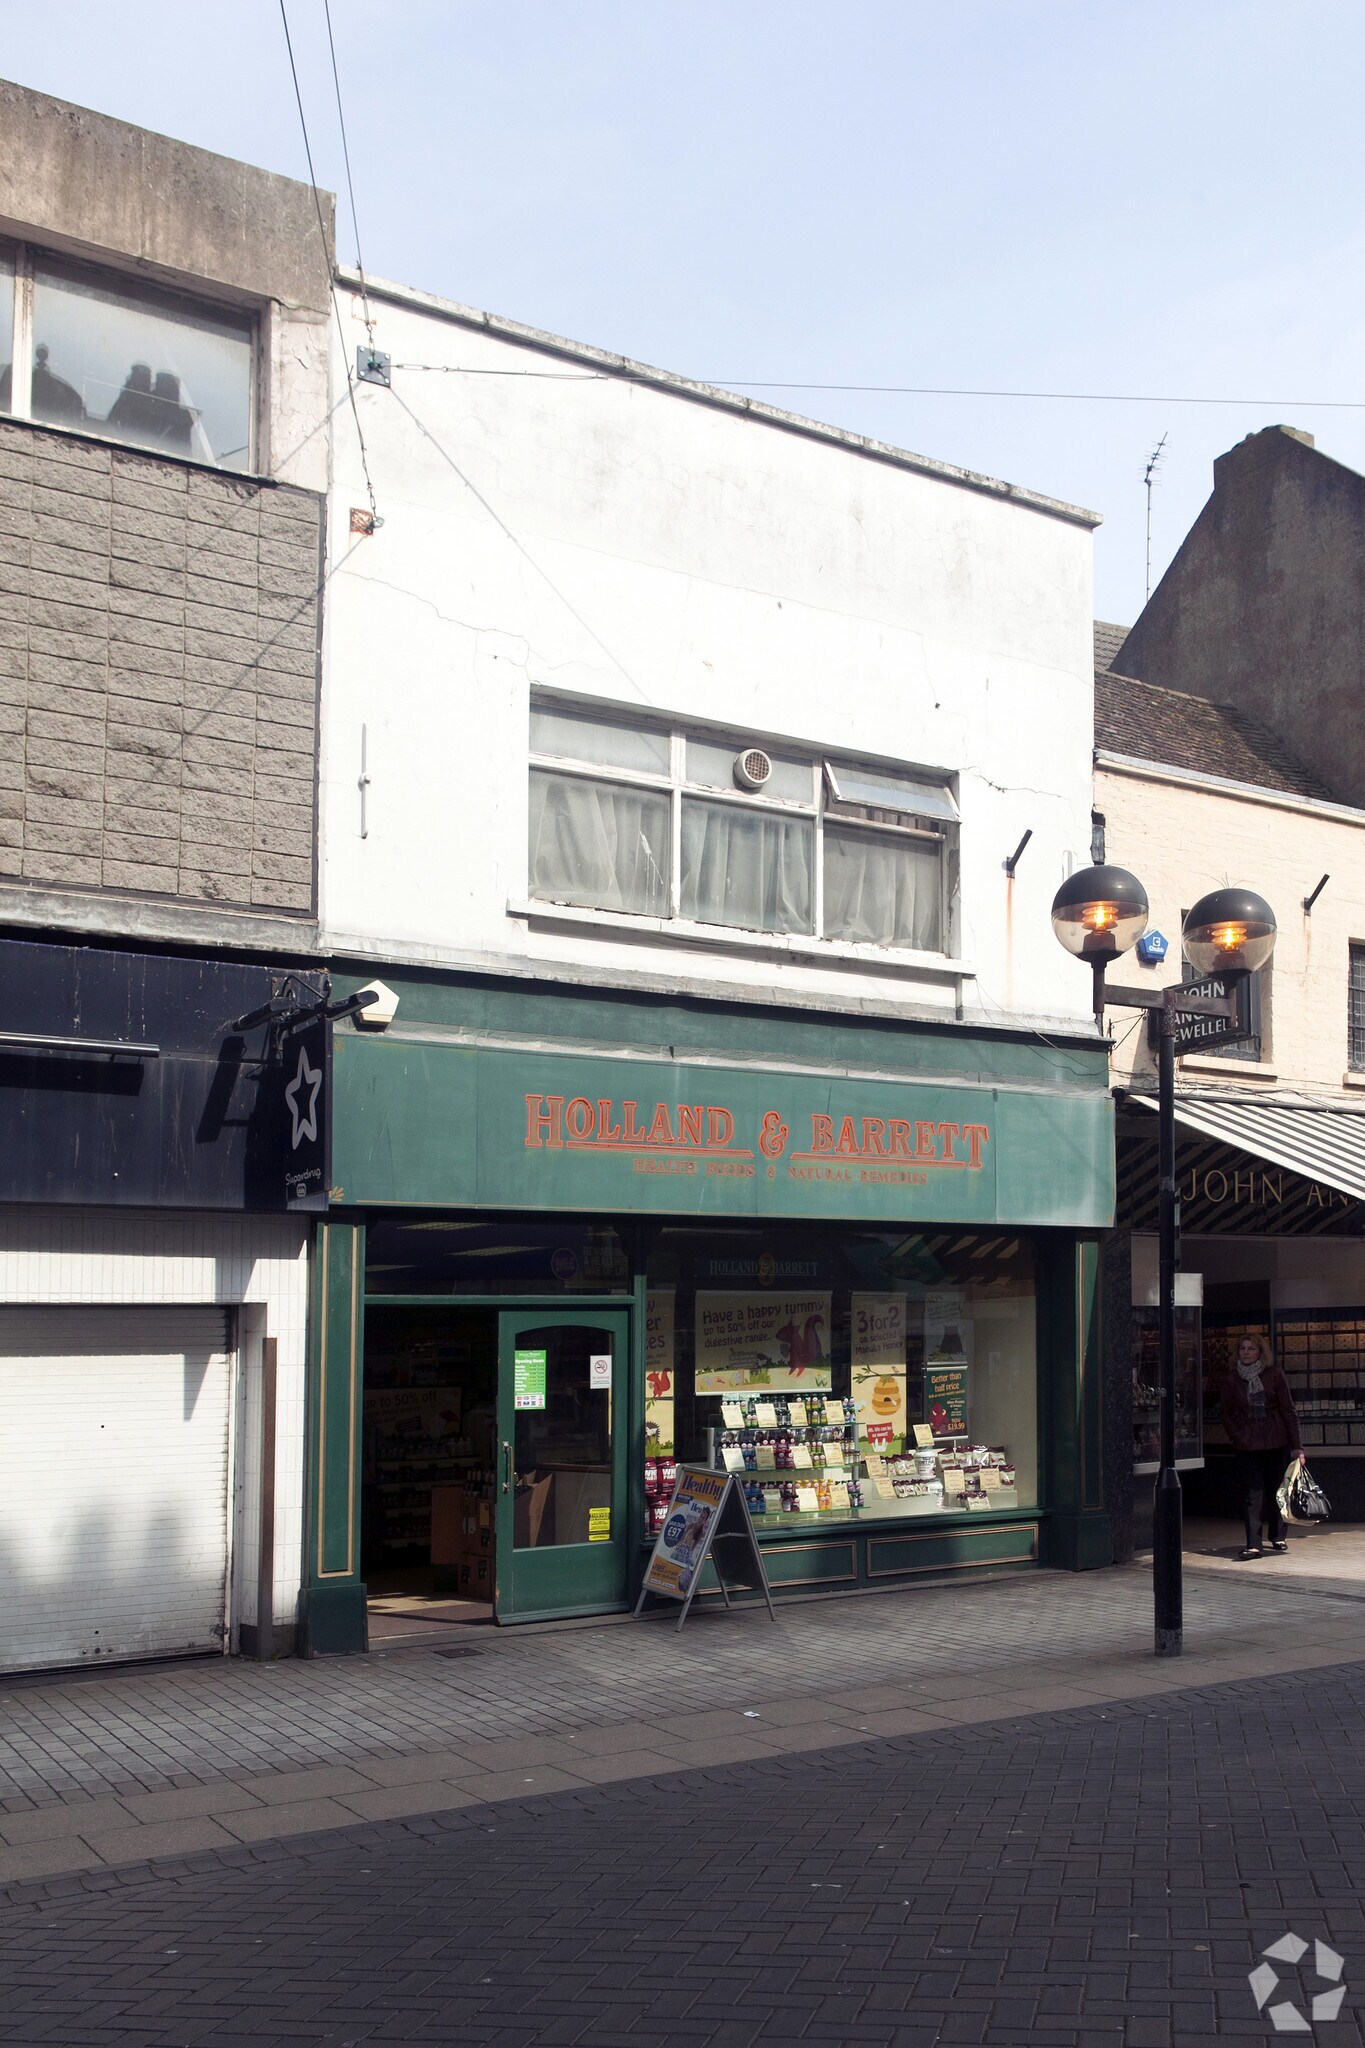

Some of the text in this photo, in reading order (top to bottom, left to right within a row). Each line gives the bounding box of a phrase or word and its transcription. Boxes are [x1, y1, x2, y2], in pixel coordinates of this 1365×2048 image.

[525, 1094, 989, 1169] HOLLAND & BARRETT
[285, 1168, 321, 1185] Superdrug
[633, 1158, 698, 1176] HEALTH
[706, 1162, 756, 1177] FOODS
[787, 1167, 852, 1182] NATURAL
[859, 1170, 928, 1185] REMEDIES
[1183, 1168, 1283, 1204] JOHN
[709, 1260, 757, 1275] HOLLAND
[772, 1261, 818, 1276] BARRETT
[703, 1301, 824, 1324] Have a happy tummy
[857, 1306, 900, 1333] 3 for 2
[704, 1319, 775, 1336] up to 50% off our
[705, 1336, 743, 1348] digestive
[856, 1341, 904, 1354] Manuka Honey
[931, 1372, 961, 1383] Better than
[935, 1382, 960, 1392] half price
[947, 1422, 965, 1431] £19.99
[682, 1475, 725, 1501] Healthy
[667, 1526, 682, 1538] £97
